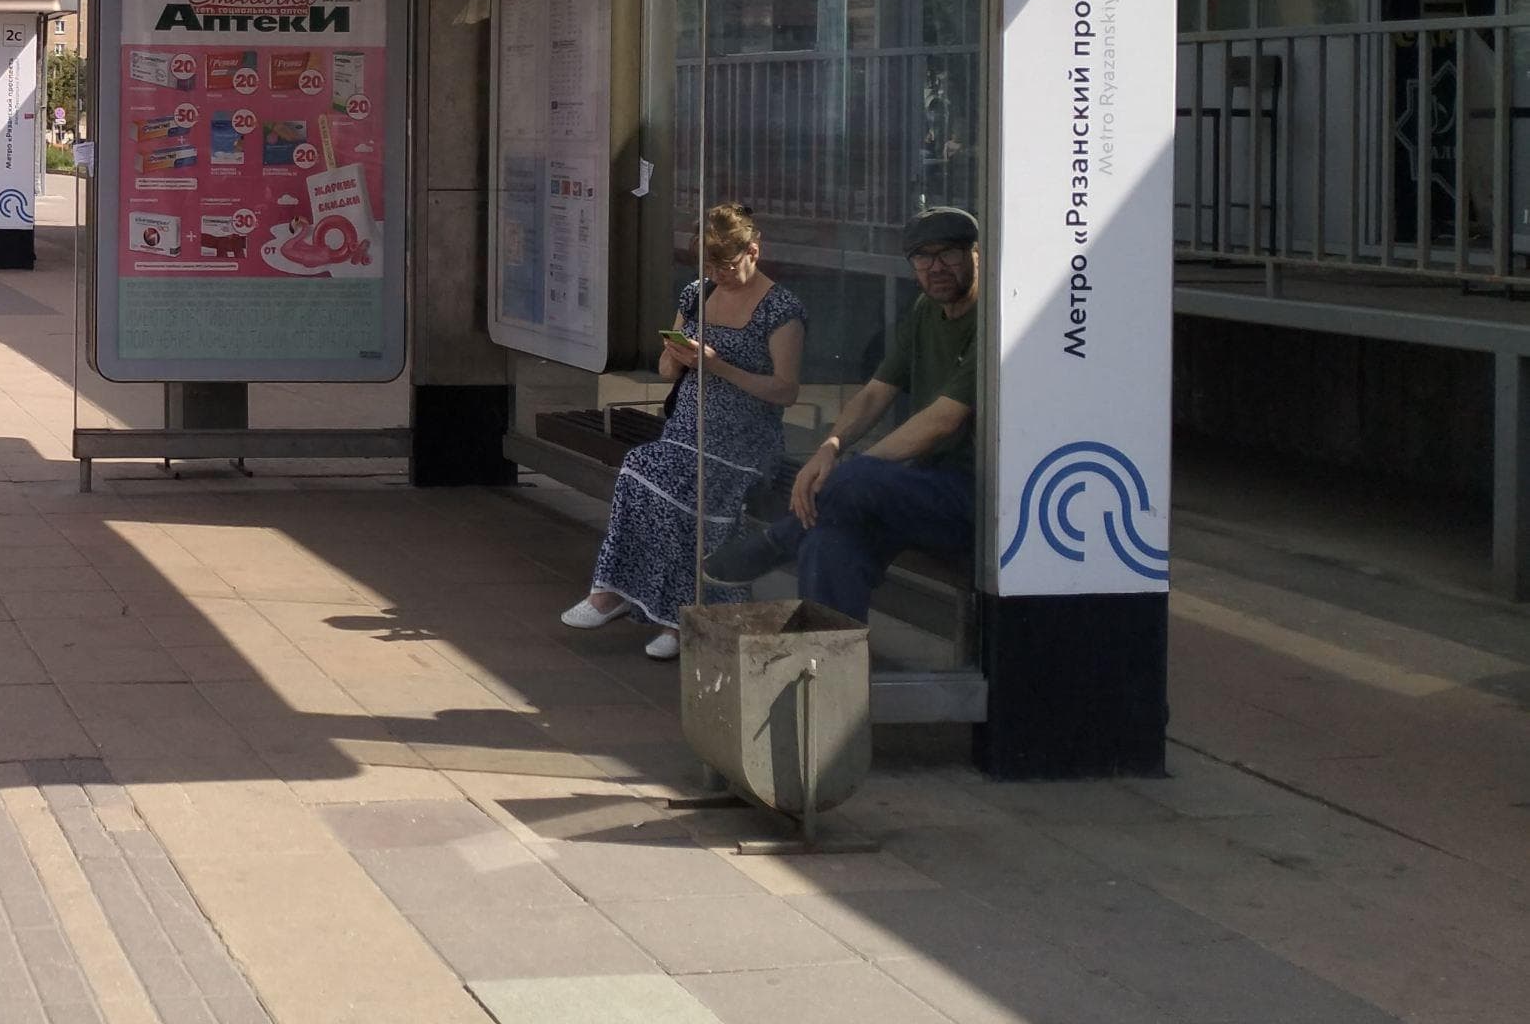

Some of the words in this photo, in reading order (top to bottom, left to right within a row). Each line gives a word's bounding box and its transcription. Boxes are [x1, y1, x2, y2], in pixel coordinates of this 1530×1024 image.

[5, 143, 13, 169] Метро
[1066, 66, 1091, 245] «Рязанский
[1098, 111, 1115, 176] Metro
[1063, 253, 1093, 359] Метро
